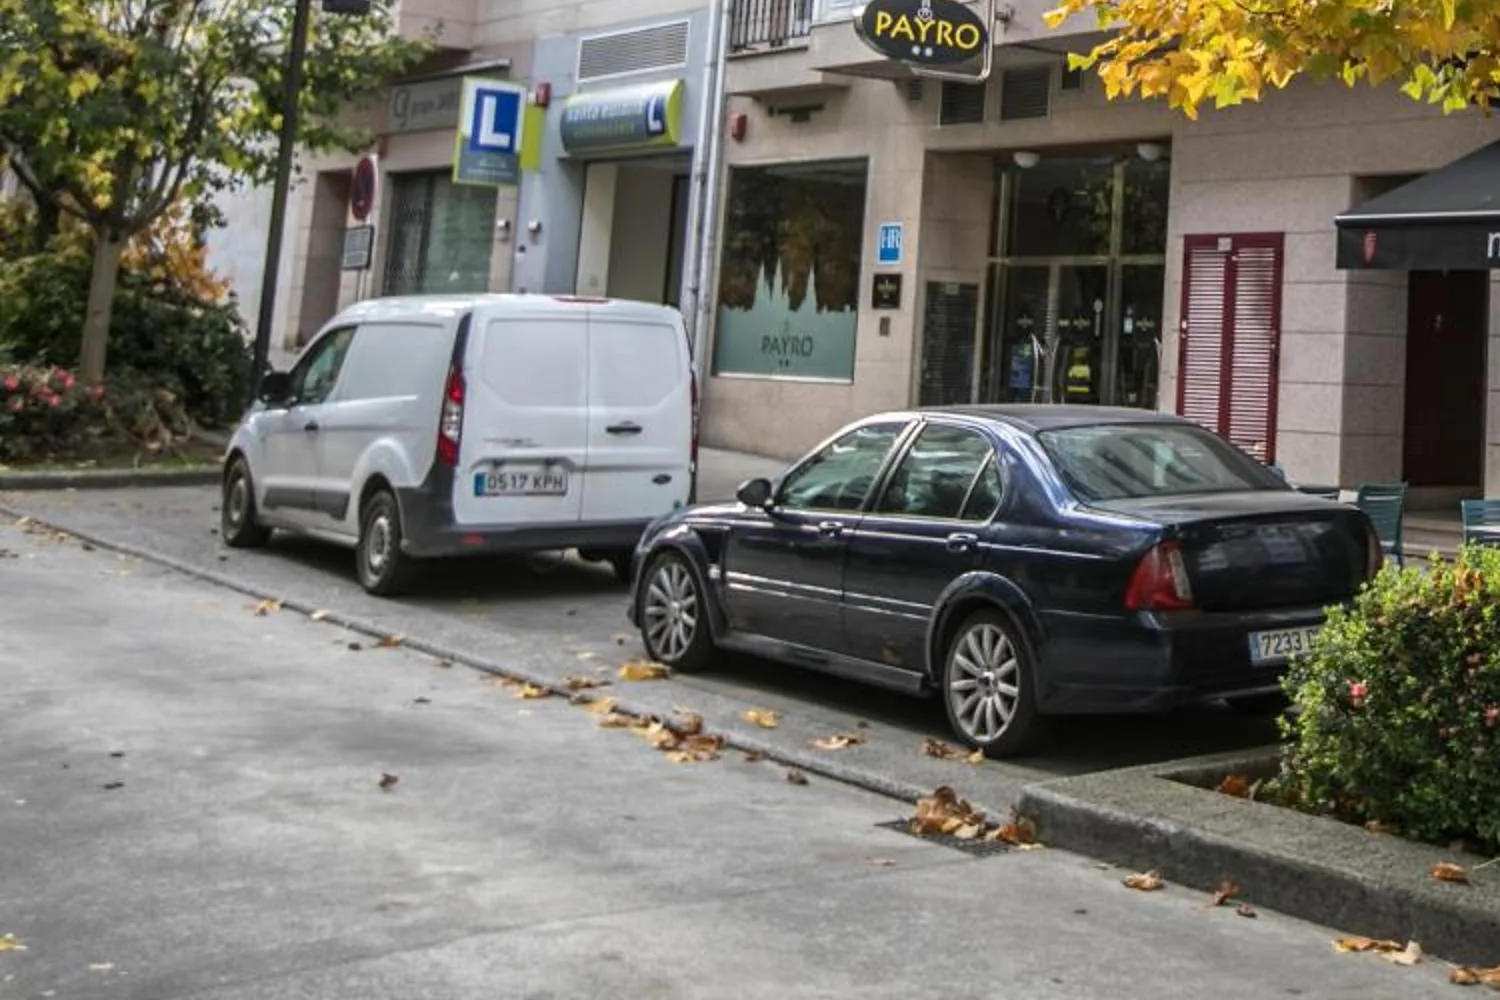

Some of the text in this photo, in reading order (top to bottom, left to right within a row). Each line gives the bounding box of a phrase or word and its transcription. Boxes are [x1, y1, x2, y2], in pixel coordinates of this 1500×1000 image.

[875, 11, 980, 50] PAYRO
[479, 95, 511, 148] L
[761, 334, 814, 357] PAYRO
[533, 475, 564, 490] KPH
[1261, 631, 1303, 657] 7233
